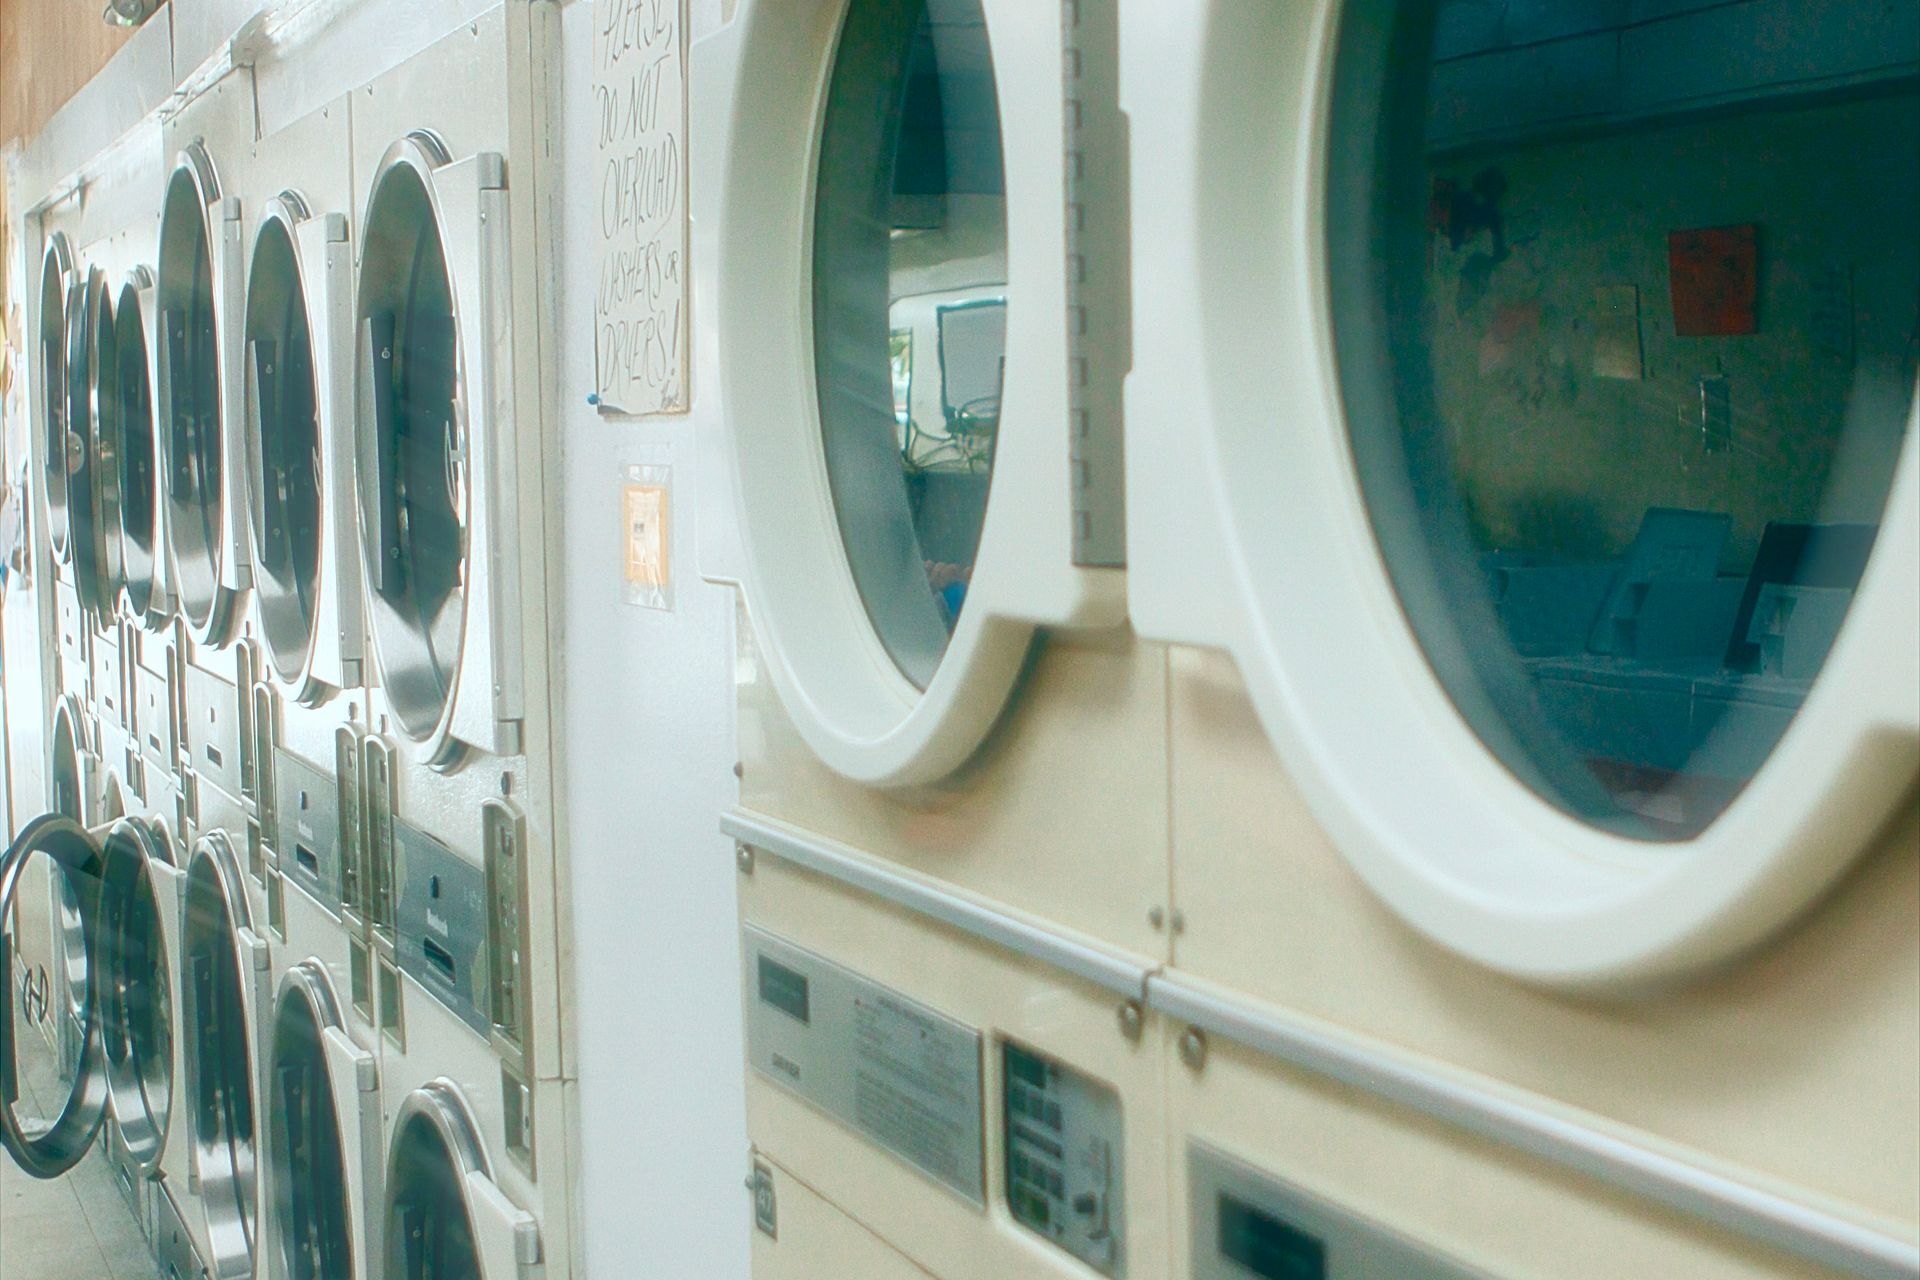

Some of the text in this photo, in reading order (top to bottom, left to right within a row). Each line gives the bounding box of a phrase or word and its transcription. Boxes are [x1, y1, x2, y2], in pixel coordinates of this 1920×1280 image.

[597, 54, 671, 150] DO NOT
[602, 132, 678, 243] OVERLOAD
[600, 240, 679, 317] WASHERS OR
[602, 299, 680, 399] DRYERS!
